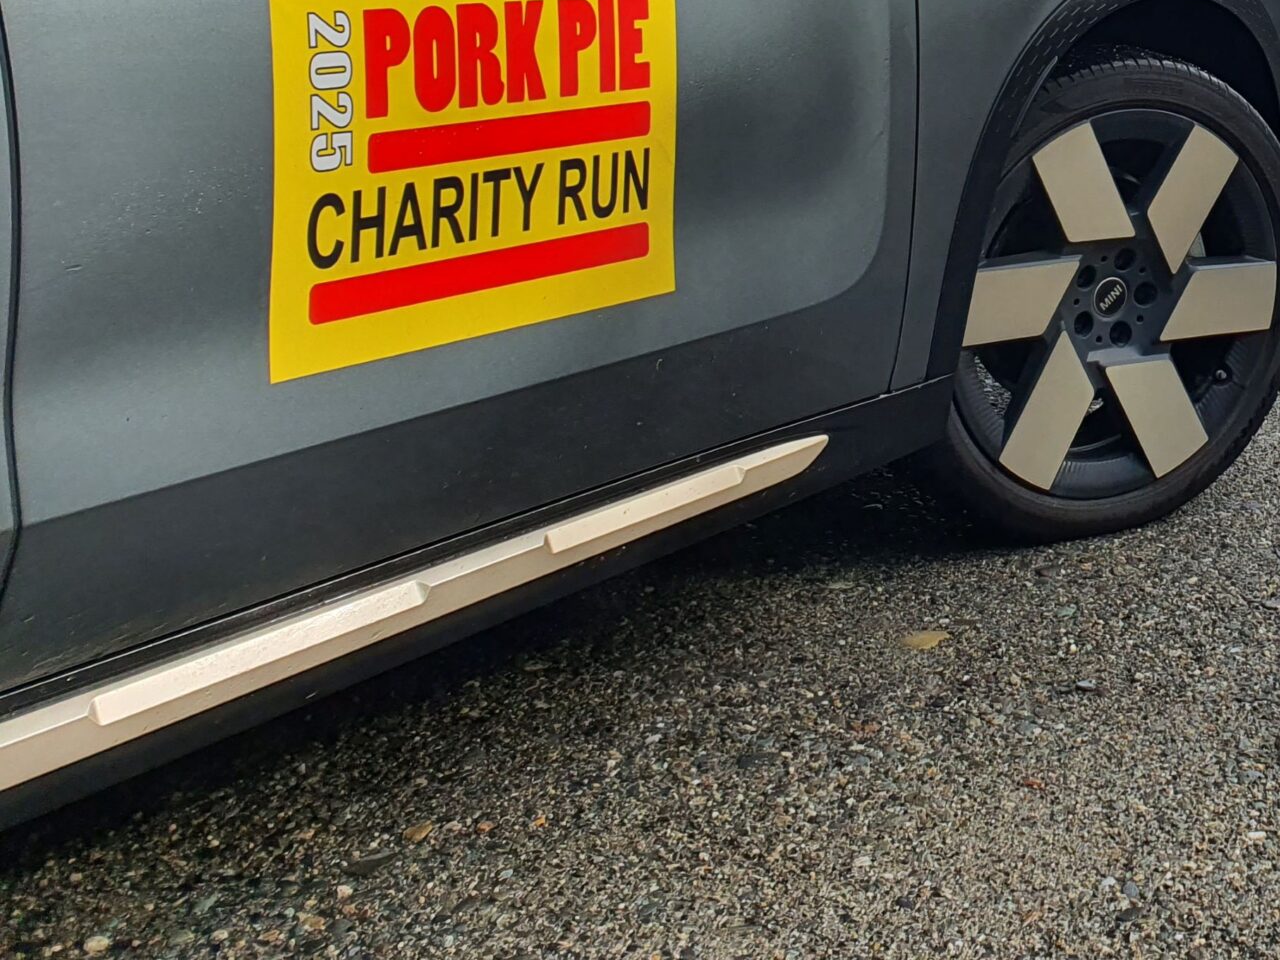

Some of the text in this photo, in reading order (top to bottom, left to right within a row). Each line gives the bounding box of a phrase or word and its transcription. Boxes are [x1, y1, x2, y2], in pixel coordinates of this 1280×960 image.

[307, 10, 353, 172] 2025
[363, 0, 547, 119] PORK
[306, 147, 650, 270] CHARITY RUN
[1100, 284, 1123, 311] MINI
